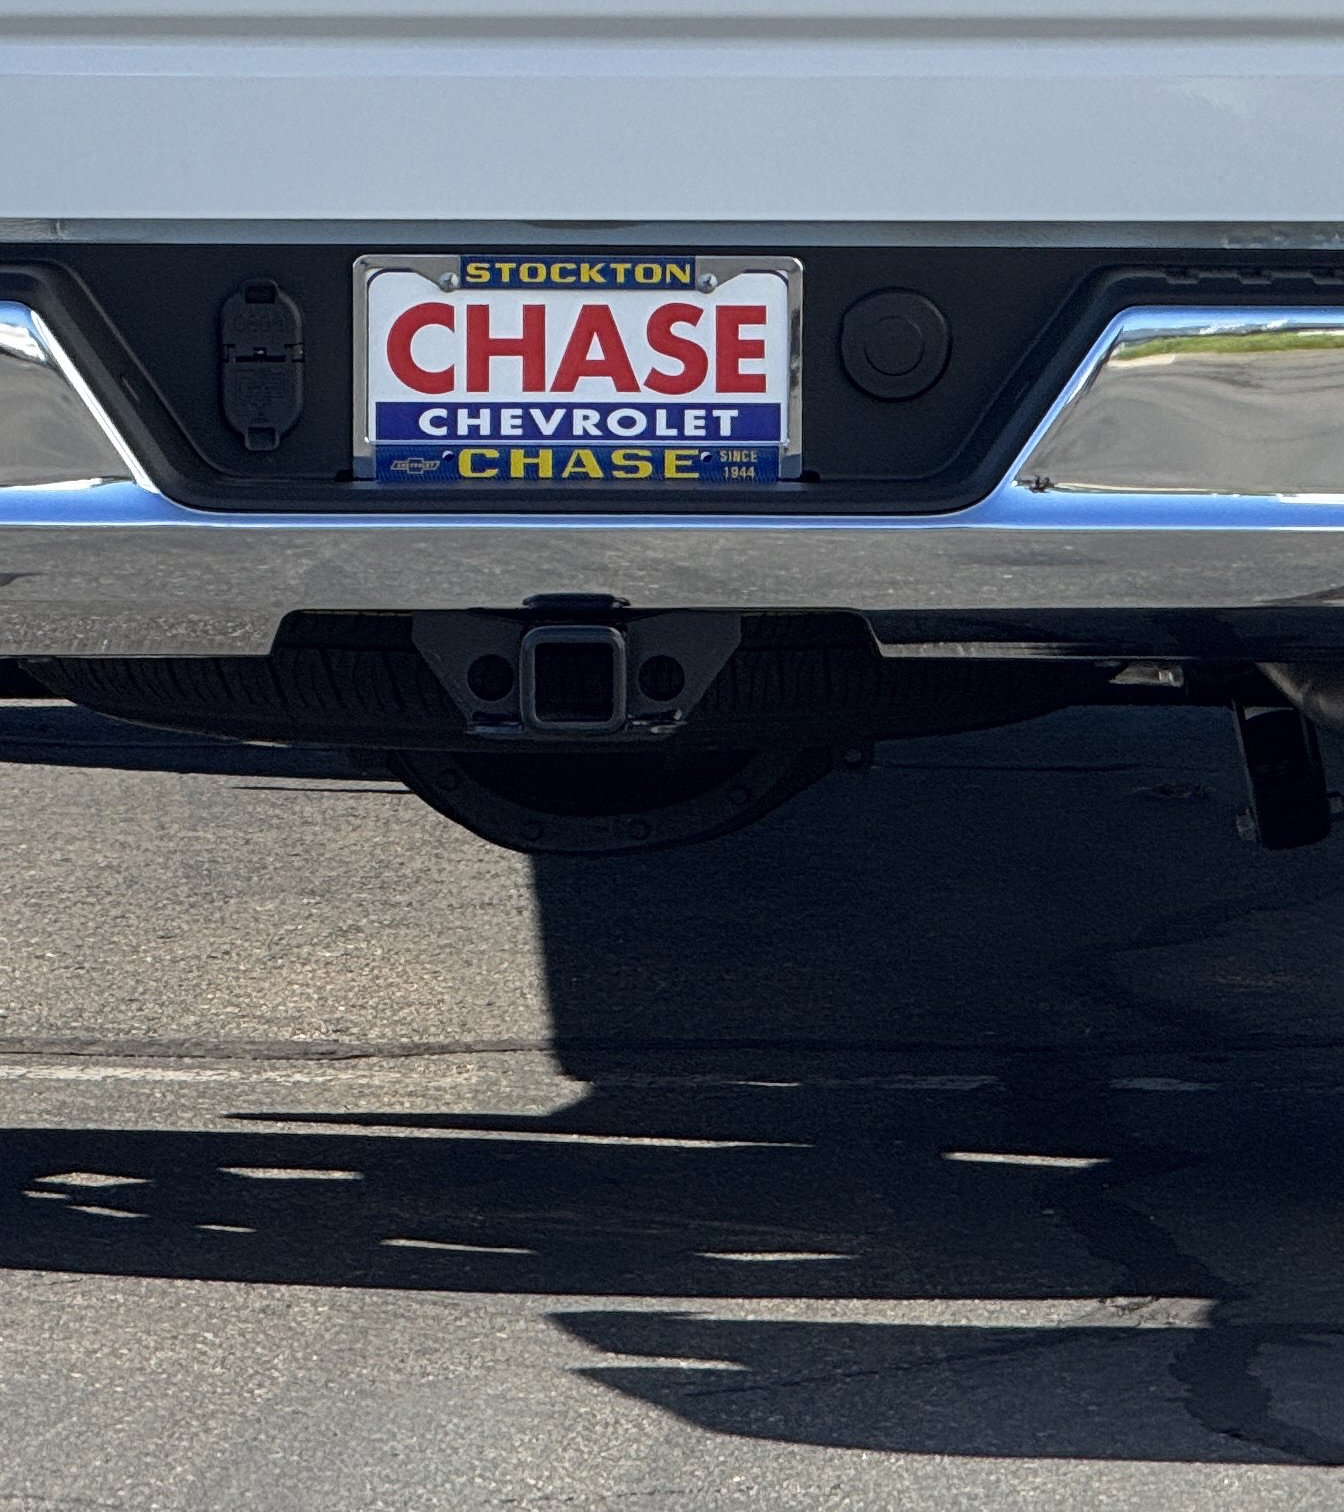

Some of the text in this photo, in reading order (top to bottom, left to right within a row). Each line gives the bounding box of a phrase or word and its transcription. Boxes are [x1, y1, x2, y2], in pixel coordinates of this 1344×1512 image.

[466, 263, 691, 284] STOCKTON
[387, 302, 767, 394] CHASE
[419, 408, 738, 437] CHEVROLET
[458, 449, 699, 479] CHASE
[720, 450, 758, 463] SINCE
[724, 466, 755, 480] 1944
